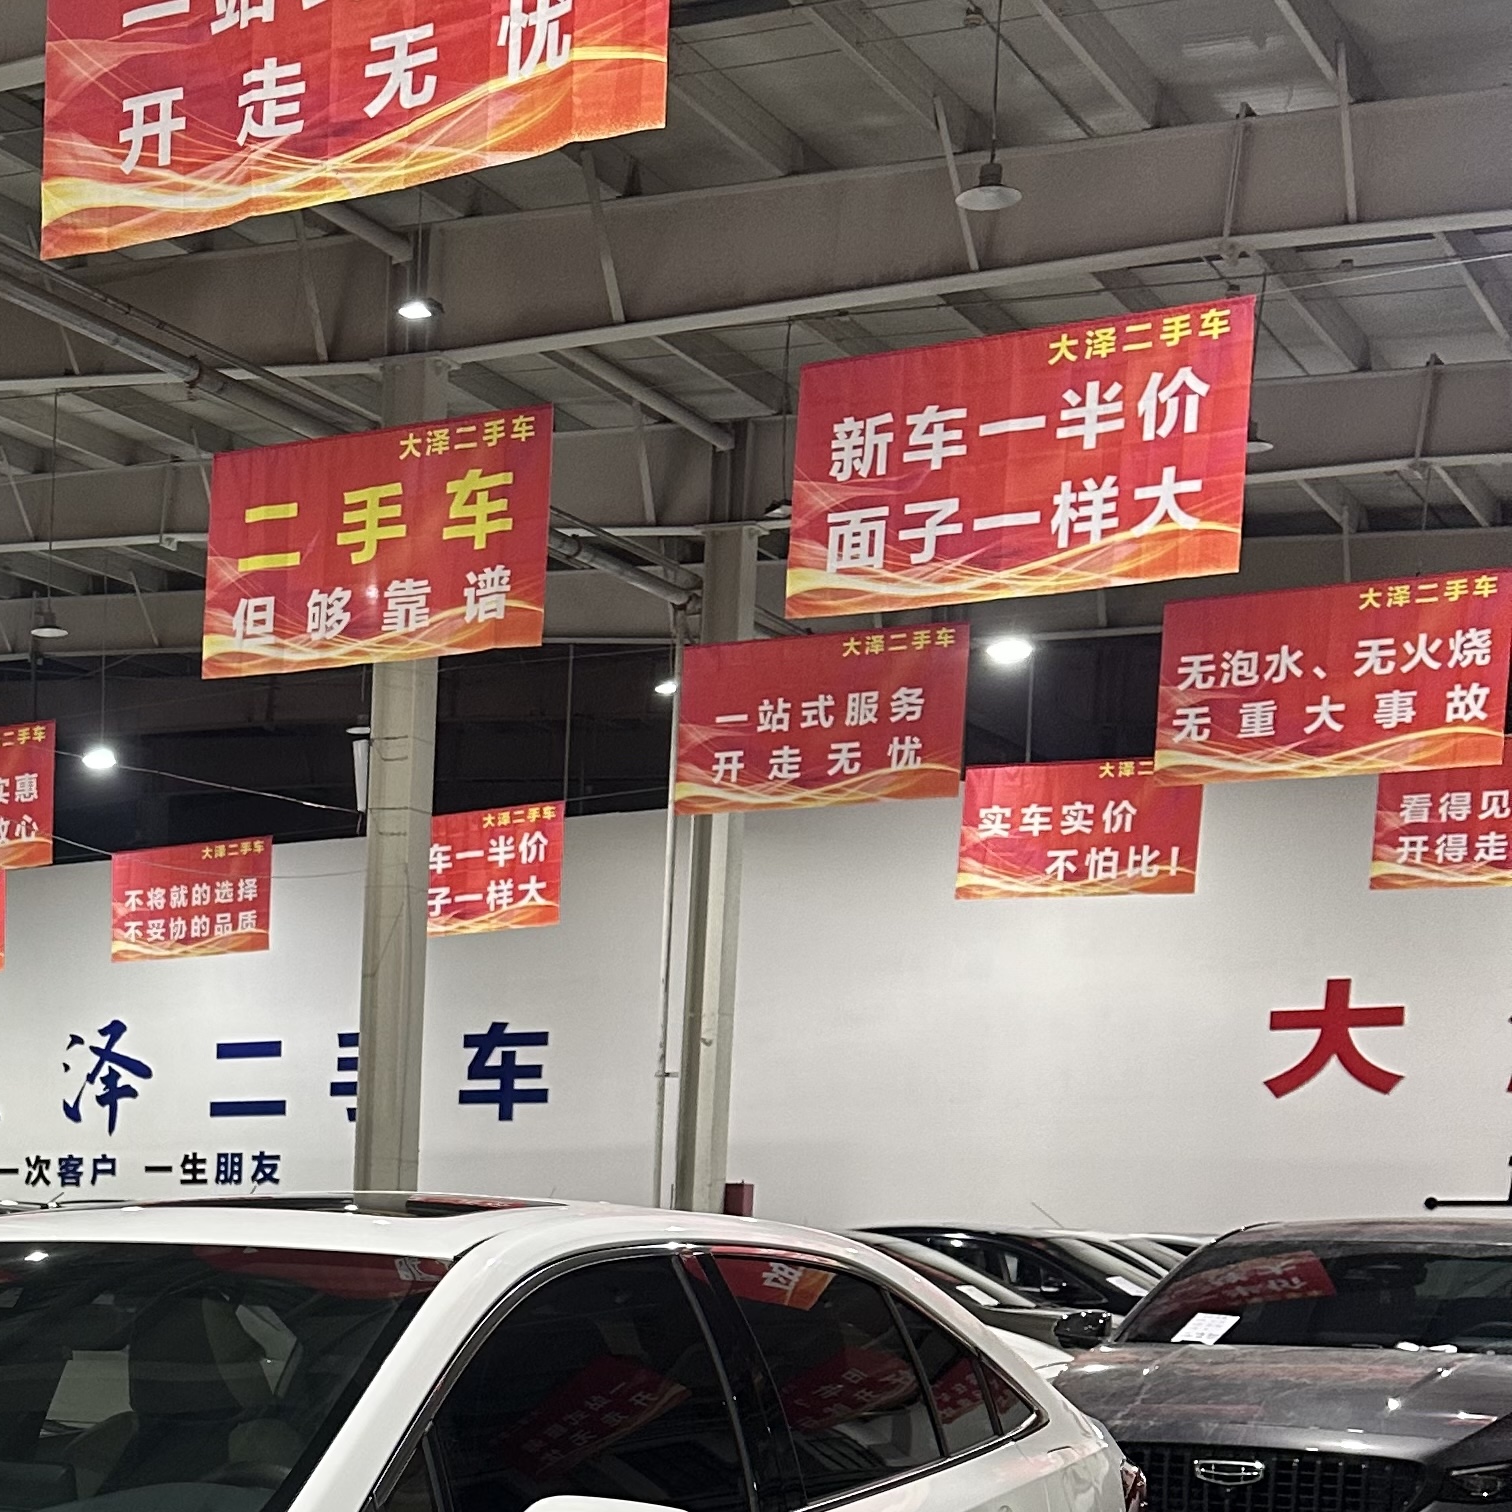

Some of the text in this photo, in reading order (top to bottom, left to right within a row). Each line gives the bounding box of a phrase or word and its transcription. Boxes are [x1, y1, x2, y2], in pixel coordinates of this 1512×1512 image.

[119, 0, 572, 174] 开走无忧
[1048, 308, 1231, 366] 大泽二手车
[399, 415, 536, 460] 大泽二手车
[828, 366, 1210, 482] 新车一半价
[238, 468, 513, 572] 二手车
[826, 466, 1202, 573] 面子一样大
[232, 565, 511, 650] 但够靠谱
[1358, 575, 1498, 610] 大泽二手车
[842, 627, 956, 658] 大泽二手车
[715, 686, 925, 733] 一站式服务
[1171, 682, 1490, 744] 无重大事故
[712, 736, 923, 785] 开走无忧
[482, 806, 557, 828] 大泽二手车
[978, 800, 1138, 838] 实车实价
[201, 839, 265, 860] 大泽二手车
[1044, 844, 1180, 881] 不怕比！
[124, 877, 258, 912] 不将就的选择
[124, 909, 258, 943] 不妥协的品质
[145, 1151, 282, 1187] 一生朋友
